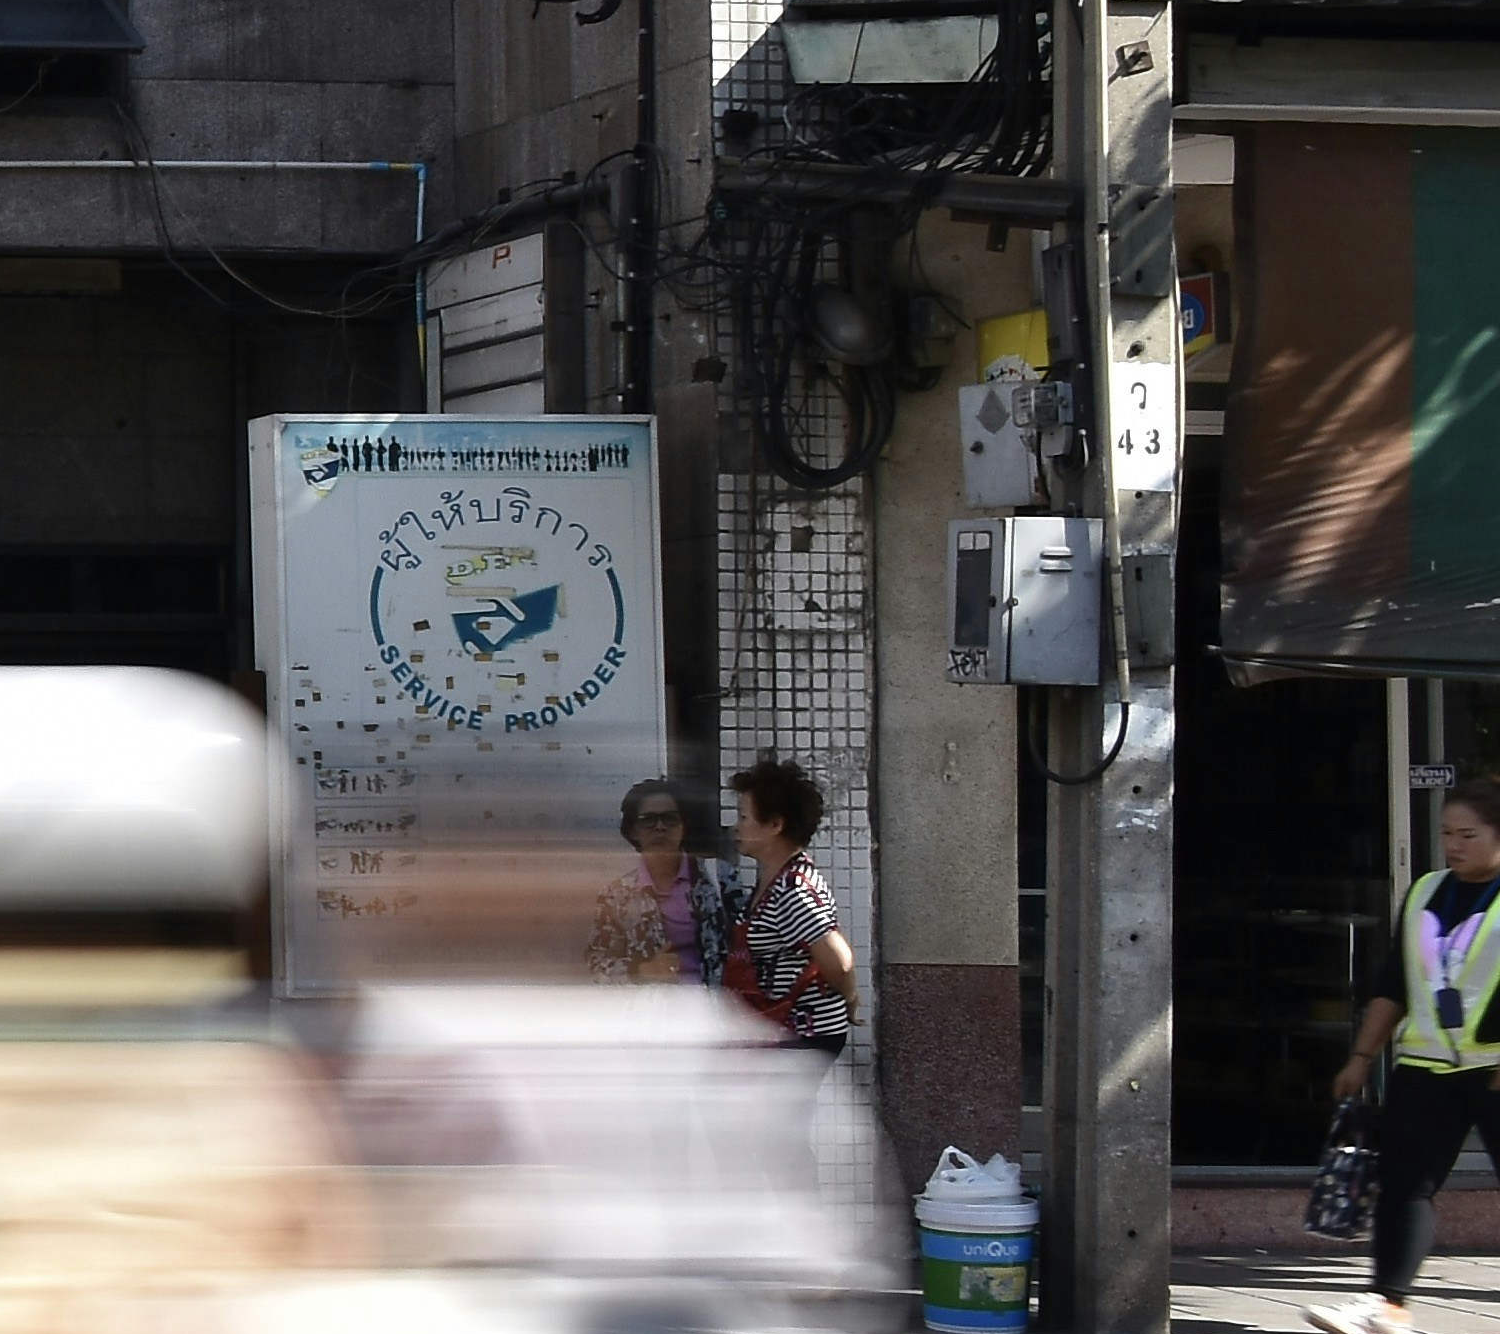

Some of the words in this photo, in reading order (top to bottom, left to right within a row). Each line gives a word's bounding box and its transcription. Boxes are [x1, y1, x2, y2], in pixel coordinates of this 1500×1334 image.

[378, 486, 612, 572] ผู้ให้บริการ
[380, 644, 484, 732] SERVICE
[504, 642, 628, 734] PROVIDER
[963, 1240, 1020, 1258] uniQue
